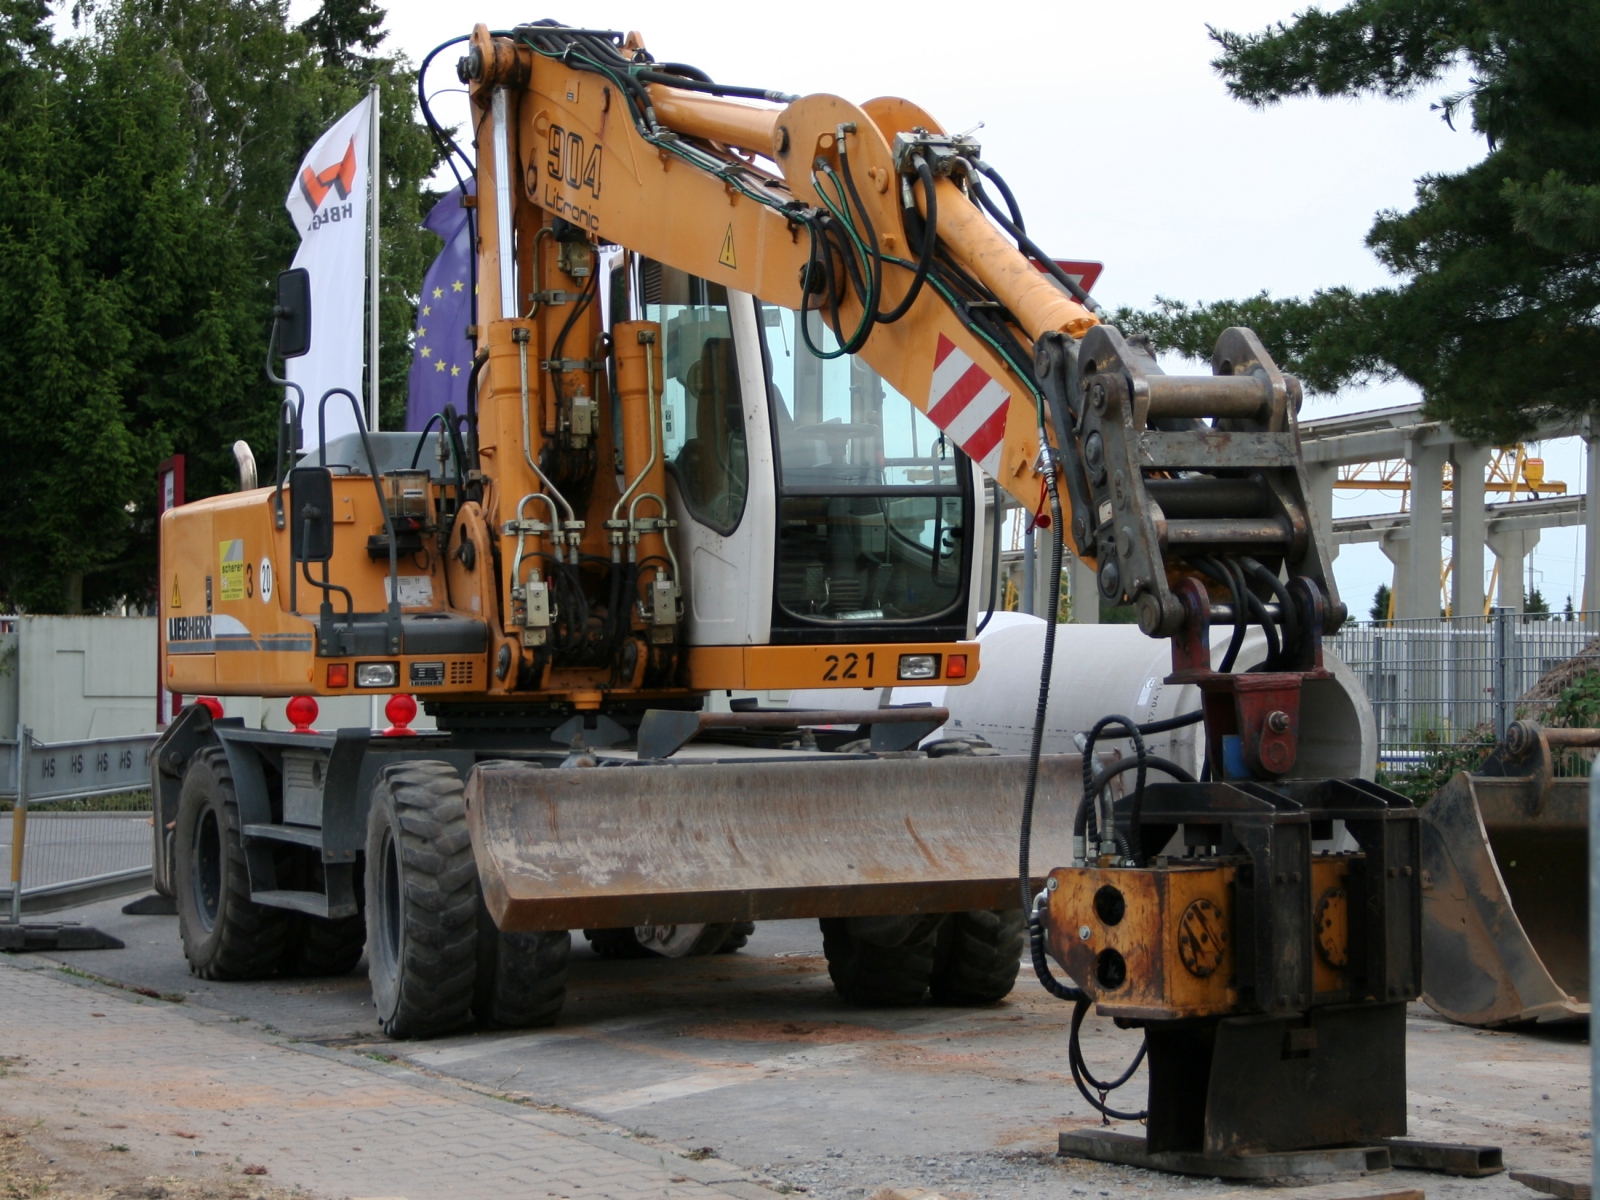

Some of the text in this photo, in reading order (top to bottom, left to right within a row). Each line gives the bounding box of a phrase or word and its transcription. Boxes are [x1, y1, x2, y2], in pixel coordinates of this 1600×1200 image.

[547, 123, 603, 200] 904
[545, 183, 599, 231] Litronic
[222, 563, 243, 574] scherer
[246, 562, 254, 599] 3
[261, 564, 271, 594] 20
[169, 615, 213, 641] LIEBHERR
[822, 652, 875, 681] 221
[43, 757, 56, 778] HS
[71, 754, 83, 774] HS
[97, 752, 109, 772] HS
[120, 749, 132, 769] HS
